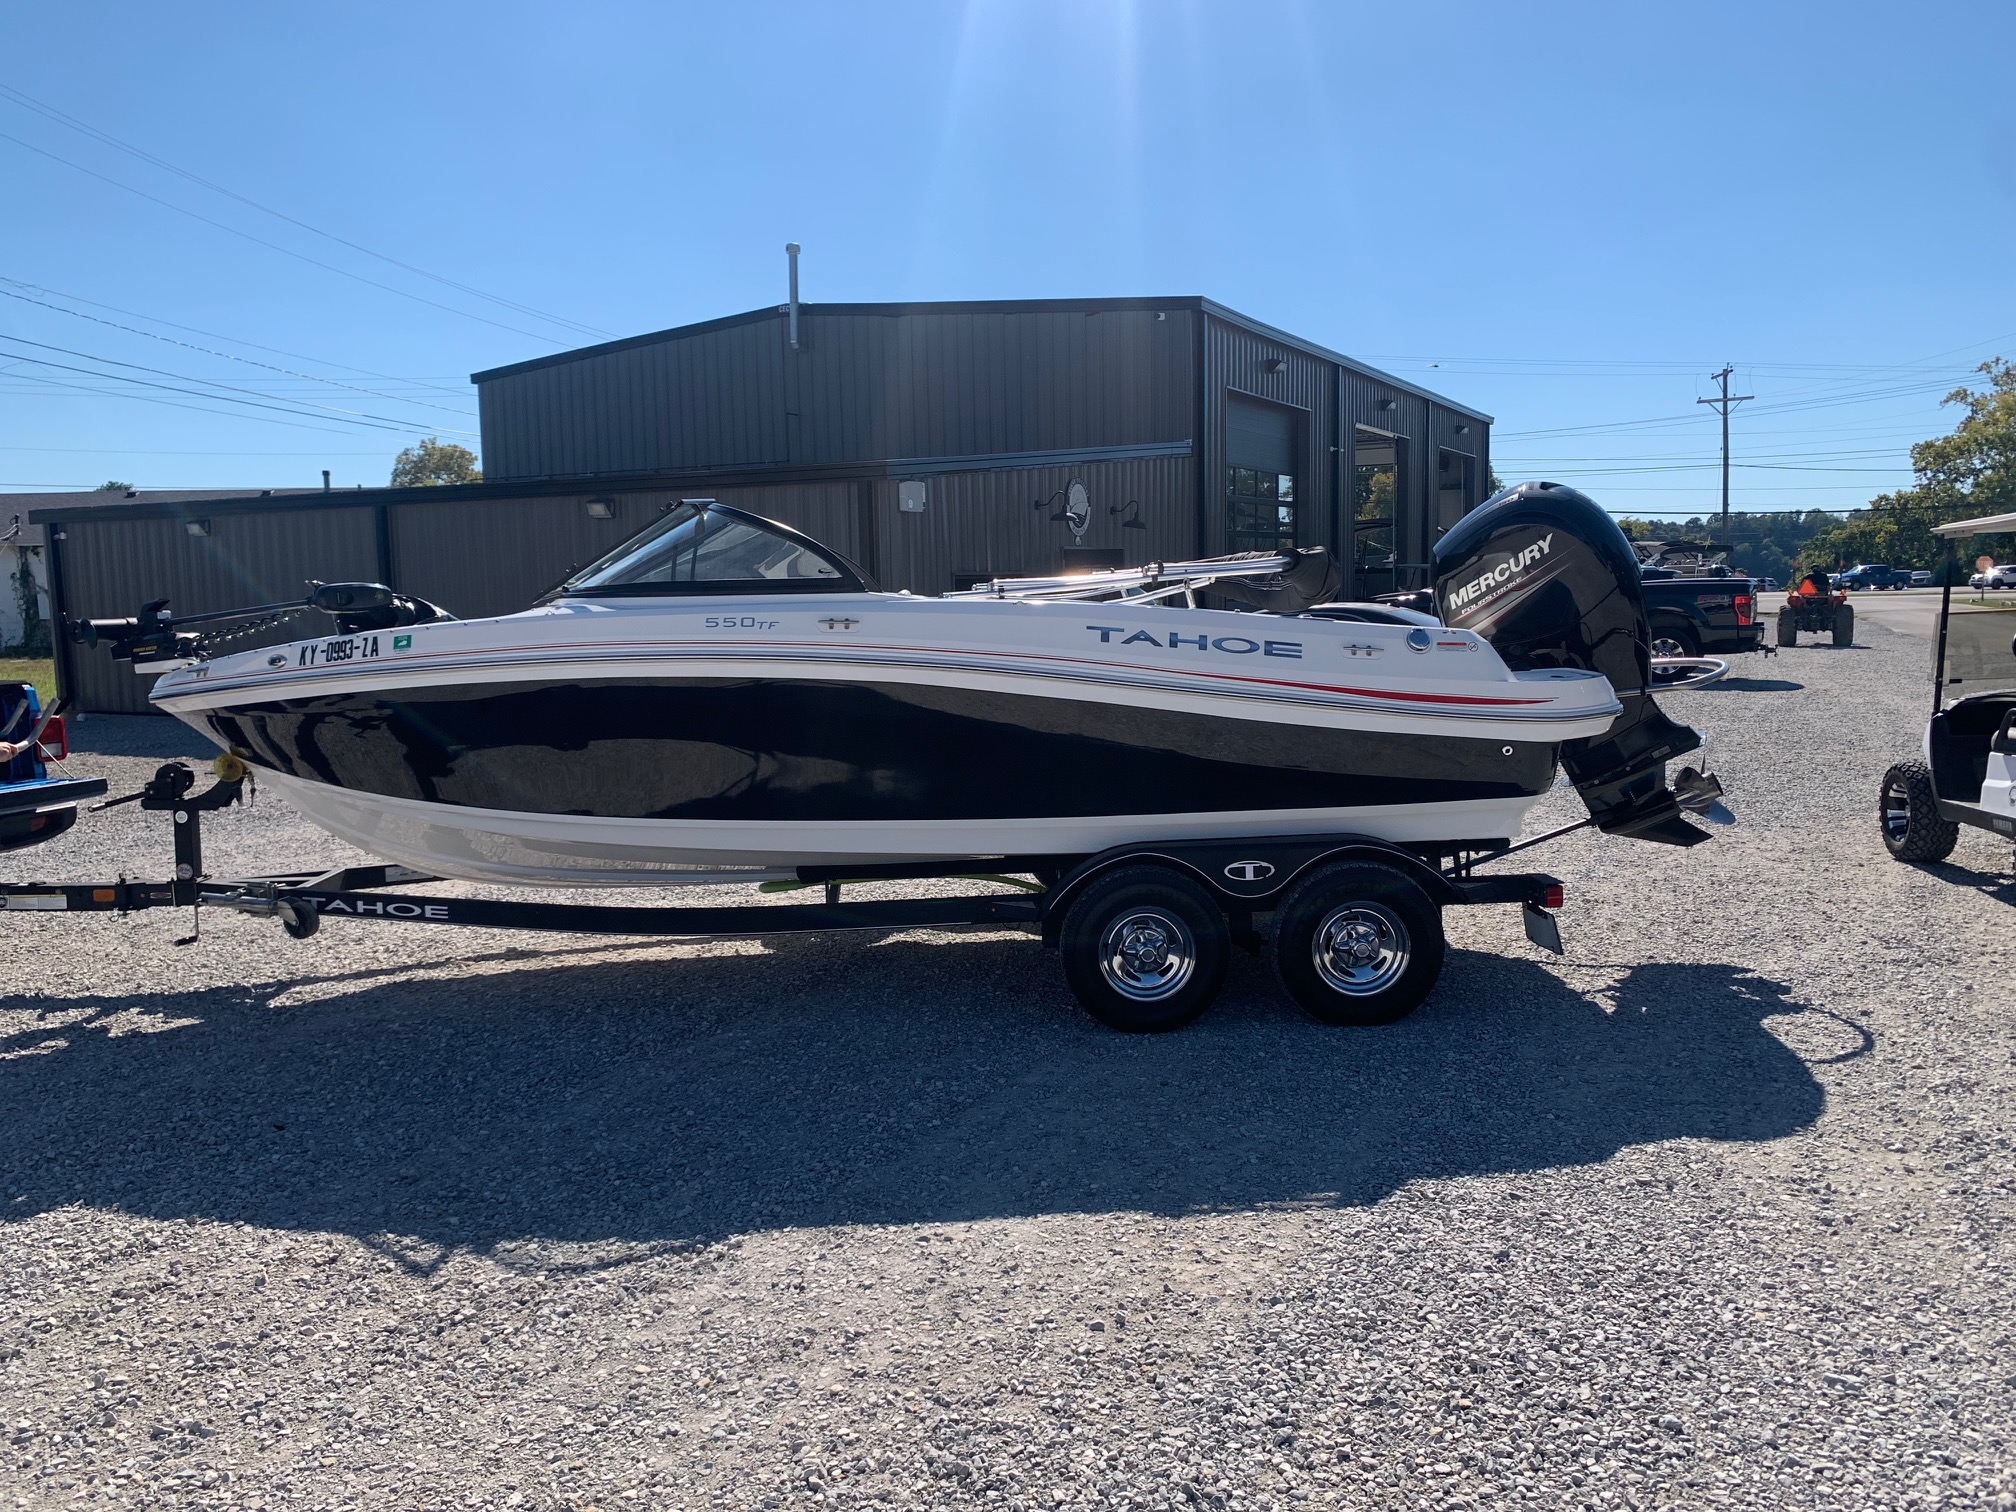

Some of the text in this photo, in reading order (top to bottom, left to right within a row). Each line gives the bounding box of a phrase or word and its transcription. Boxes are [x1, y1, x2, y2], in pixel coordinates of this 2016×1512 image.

[1449, 533, 1553, 609] MERCURY
[1461, 577, 1522, 614] FOURSTROKE
[1086, 625, 1302, 659] TAHOE
[302, 897, 448, 919] TAHOE
